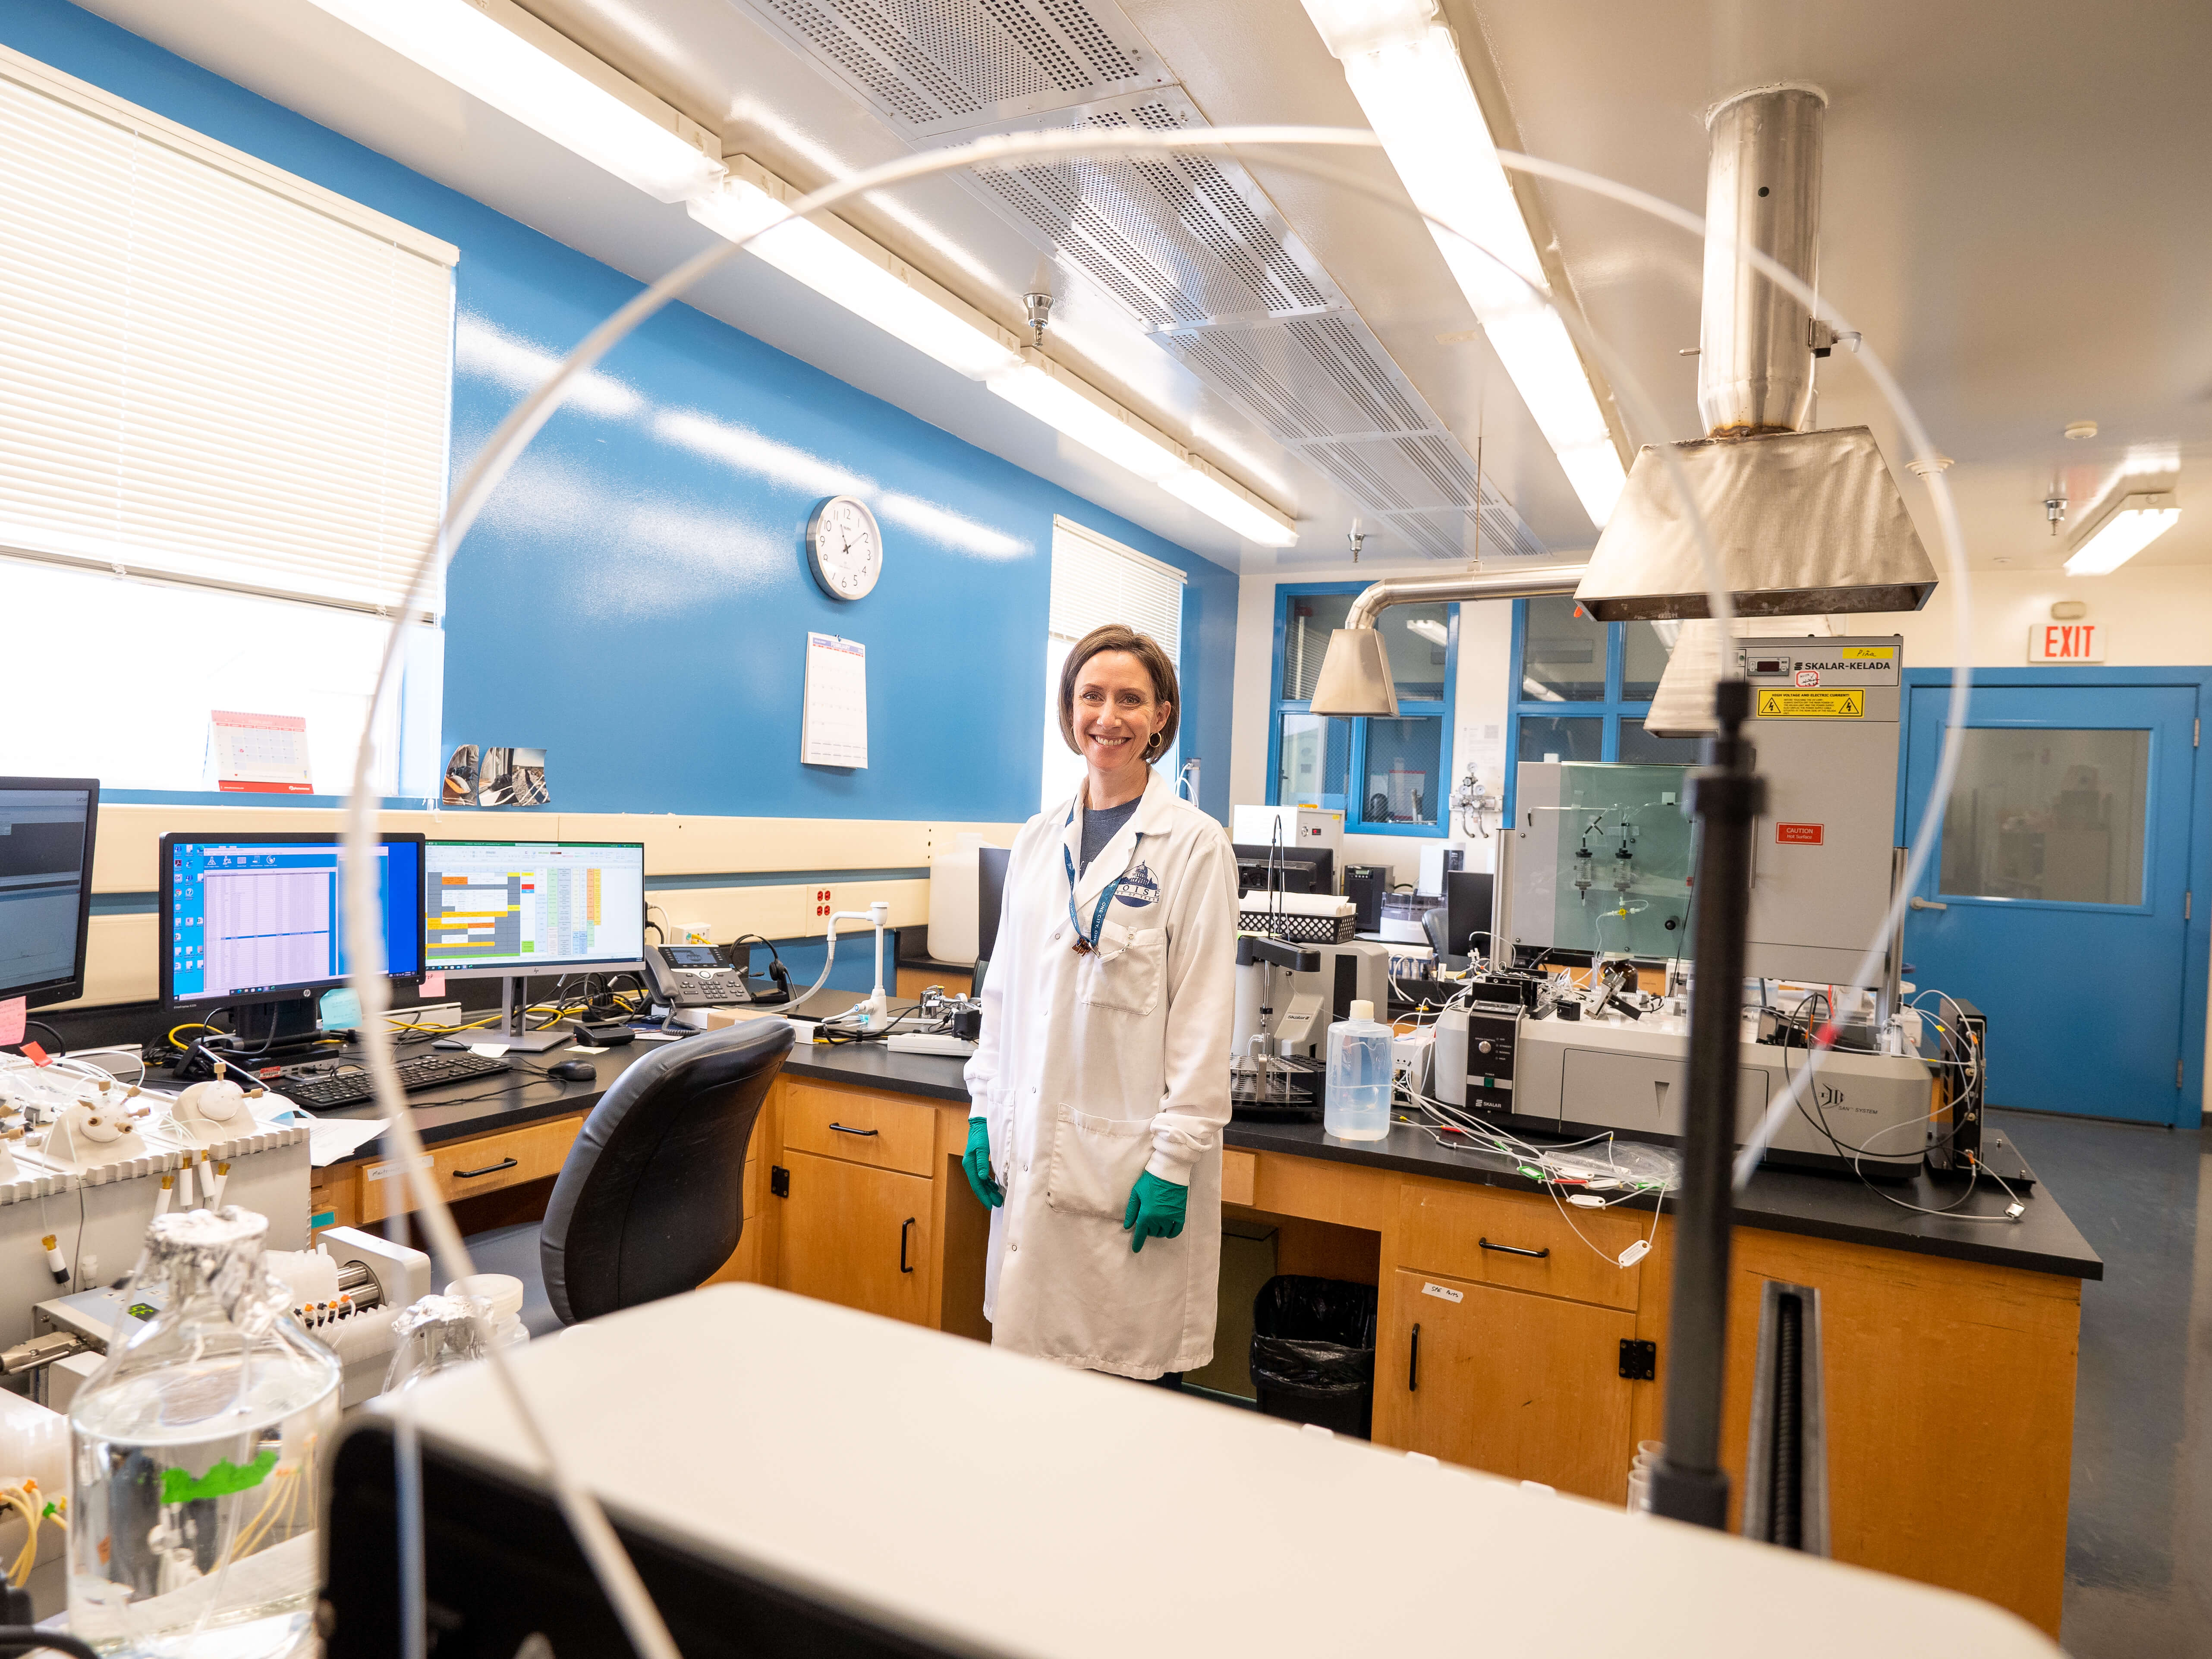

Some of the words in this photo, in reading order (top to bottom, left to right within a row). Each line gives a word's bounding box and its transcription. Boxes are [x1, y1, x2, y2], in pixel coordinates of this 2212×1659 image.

[834, 510, 838, 521] 11
[843, 508, 850, 520] 12
[824, 519, 832, 532] 10
[820, 535, 825, 547] 9
[864, 532, 868, 543] 2
[866, 549, 871, 560] 3
[862, 566, 866, 577] 4
[841, 576, 847, 588] 6
[853, 574, 858, 586] 5
[2045, 626, 2095, 657] EXIT
[1805, 662, 1891, 670] SKALAR-KELADA
